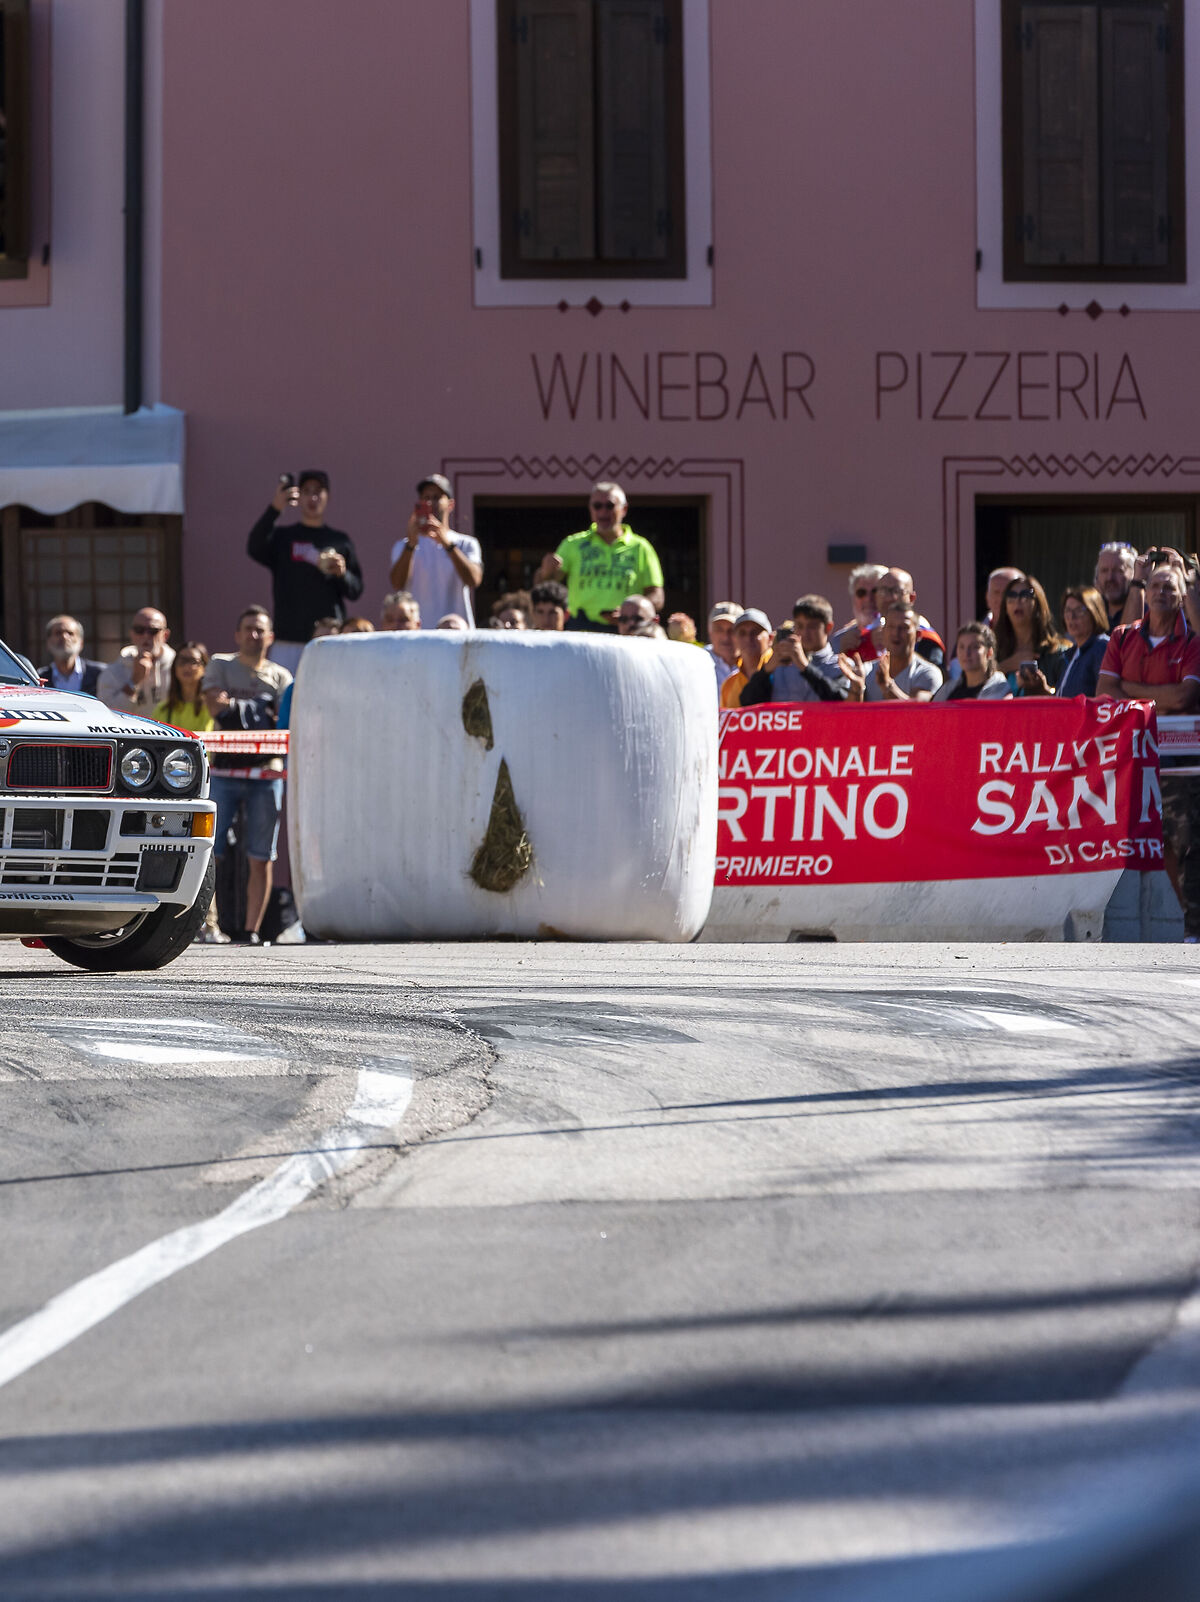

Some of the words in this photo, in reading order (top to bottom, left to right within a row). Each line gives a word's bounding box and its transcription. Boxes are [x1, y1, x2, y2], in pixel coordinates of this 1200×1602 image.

[530, 352, 816, 421] WINEBAR
[875, 352, 1148, 421] PIZZERIA
[87, 726, 169, 736] MICHELIN
[979, 731, 1120, 773] RALLYE
[971, 769, 1117, 836] SAN
[1044, 843, 1075, 866] DI
[1078, 837, 1164, 862] CASTR
